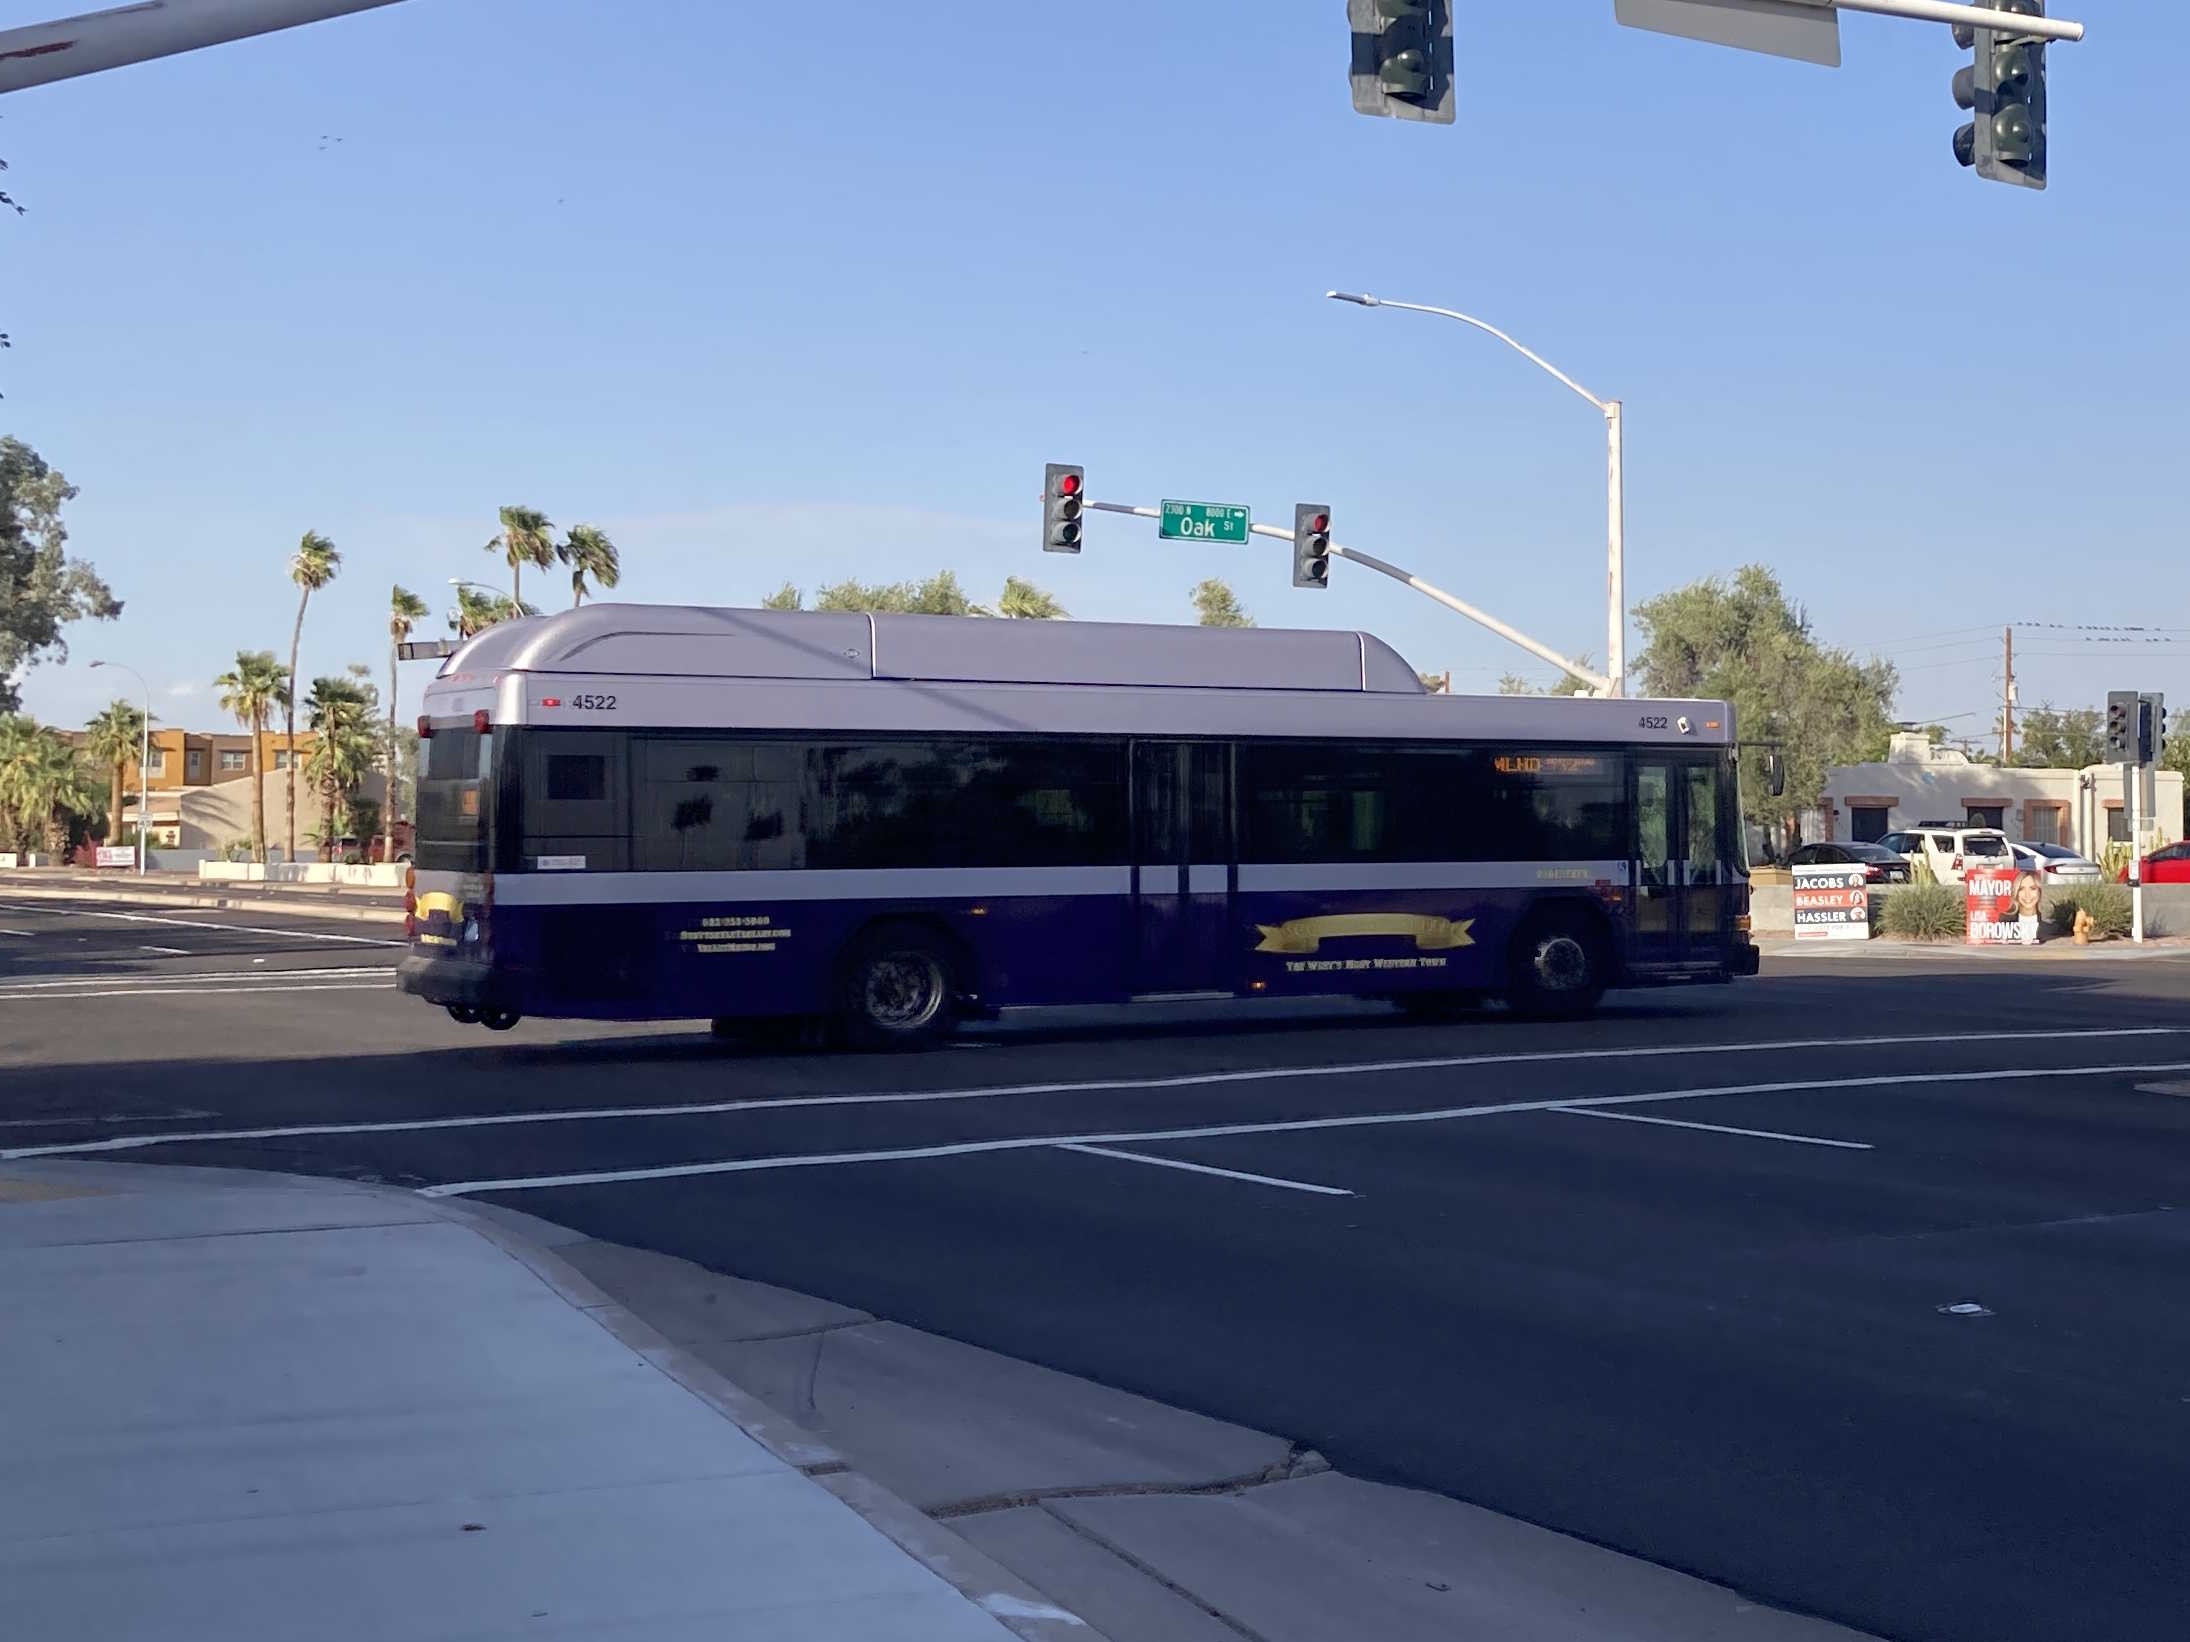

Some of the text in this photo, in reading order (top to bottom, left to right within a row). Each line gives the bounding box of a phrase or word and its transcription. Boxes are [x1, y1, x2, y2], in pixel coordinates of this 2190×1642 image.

[1180, 517, 1234, 537] Oak St
[572, 695, 617, 710] 4522
[1639, 717, 1668, 729] 4522
[1795, 877, 1844, 890] JACOBS
[1969, 879, 2012, 896] MAYOR
[1796, 895, 1843, 907] BEASLEY
[1796, 911, 1847, 923] HASSLER
[1970, 922, 2040, 940] BOROWSY
